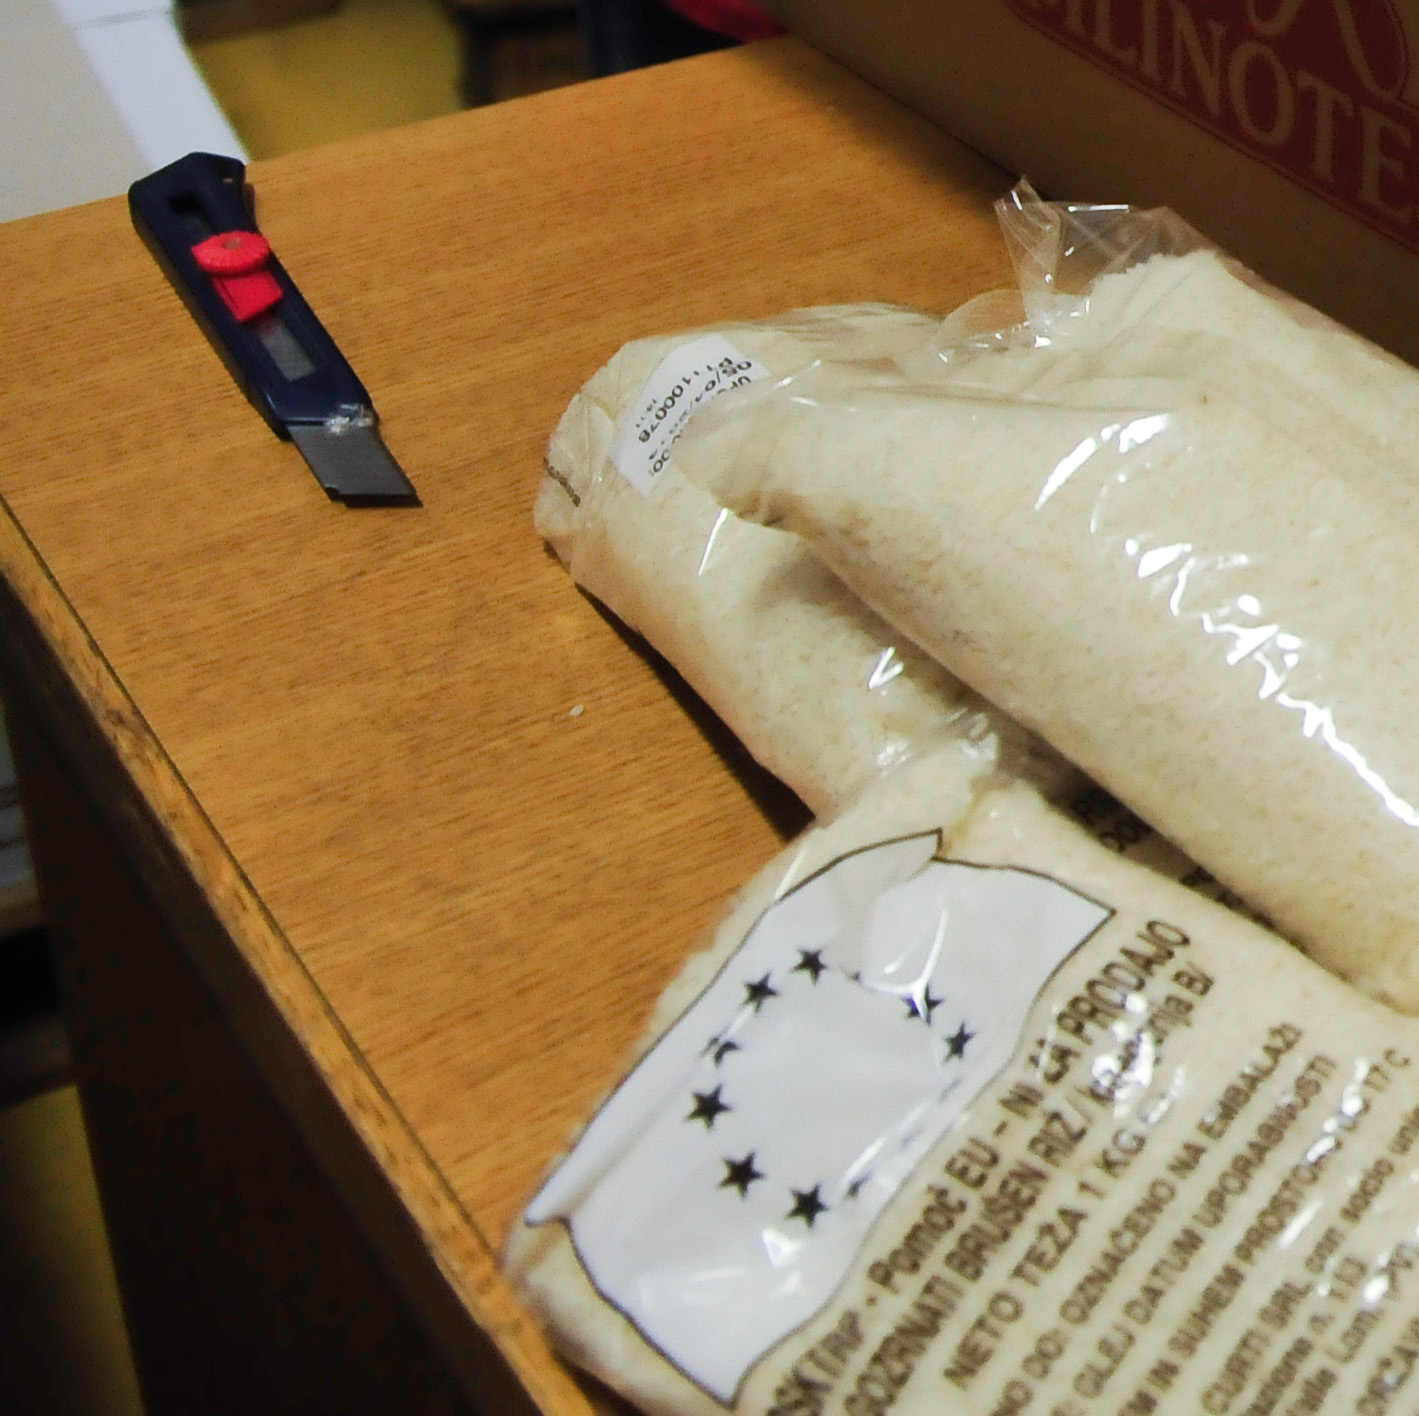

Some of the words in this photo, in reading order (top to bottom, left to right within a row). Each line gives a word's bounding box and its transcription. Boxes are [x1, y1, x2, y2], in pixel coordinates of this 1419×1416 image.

[866, 1183, 968, 1294] Pomoč
[943, 1137, 1001, 1191] EU
[998, 1081, 1044, 1120] NI
[1054, 919, 1191, 1046] PRODAJO
[942, 1160, 1050, 1282] BRUŠEN
[942, 1290, 1024, 1390] NETO
[1009, 1206, 1089, 1287] TEŽA
[1091, 1128, 1147, 1179] KG
[1057, 1177, 1177, 1327] OZNAČENO
[1166, 1141, 1209, 1180] NA
[1166, 1262, 1246, 1359] SUHEM
[1072, 1323, 1137, 1400] GLEJ
[1122, 1226, 1206, 1326] DATUM
